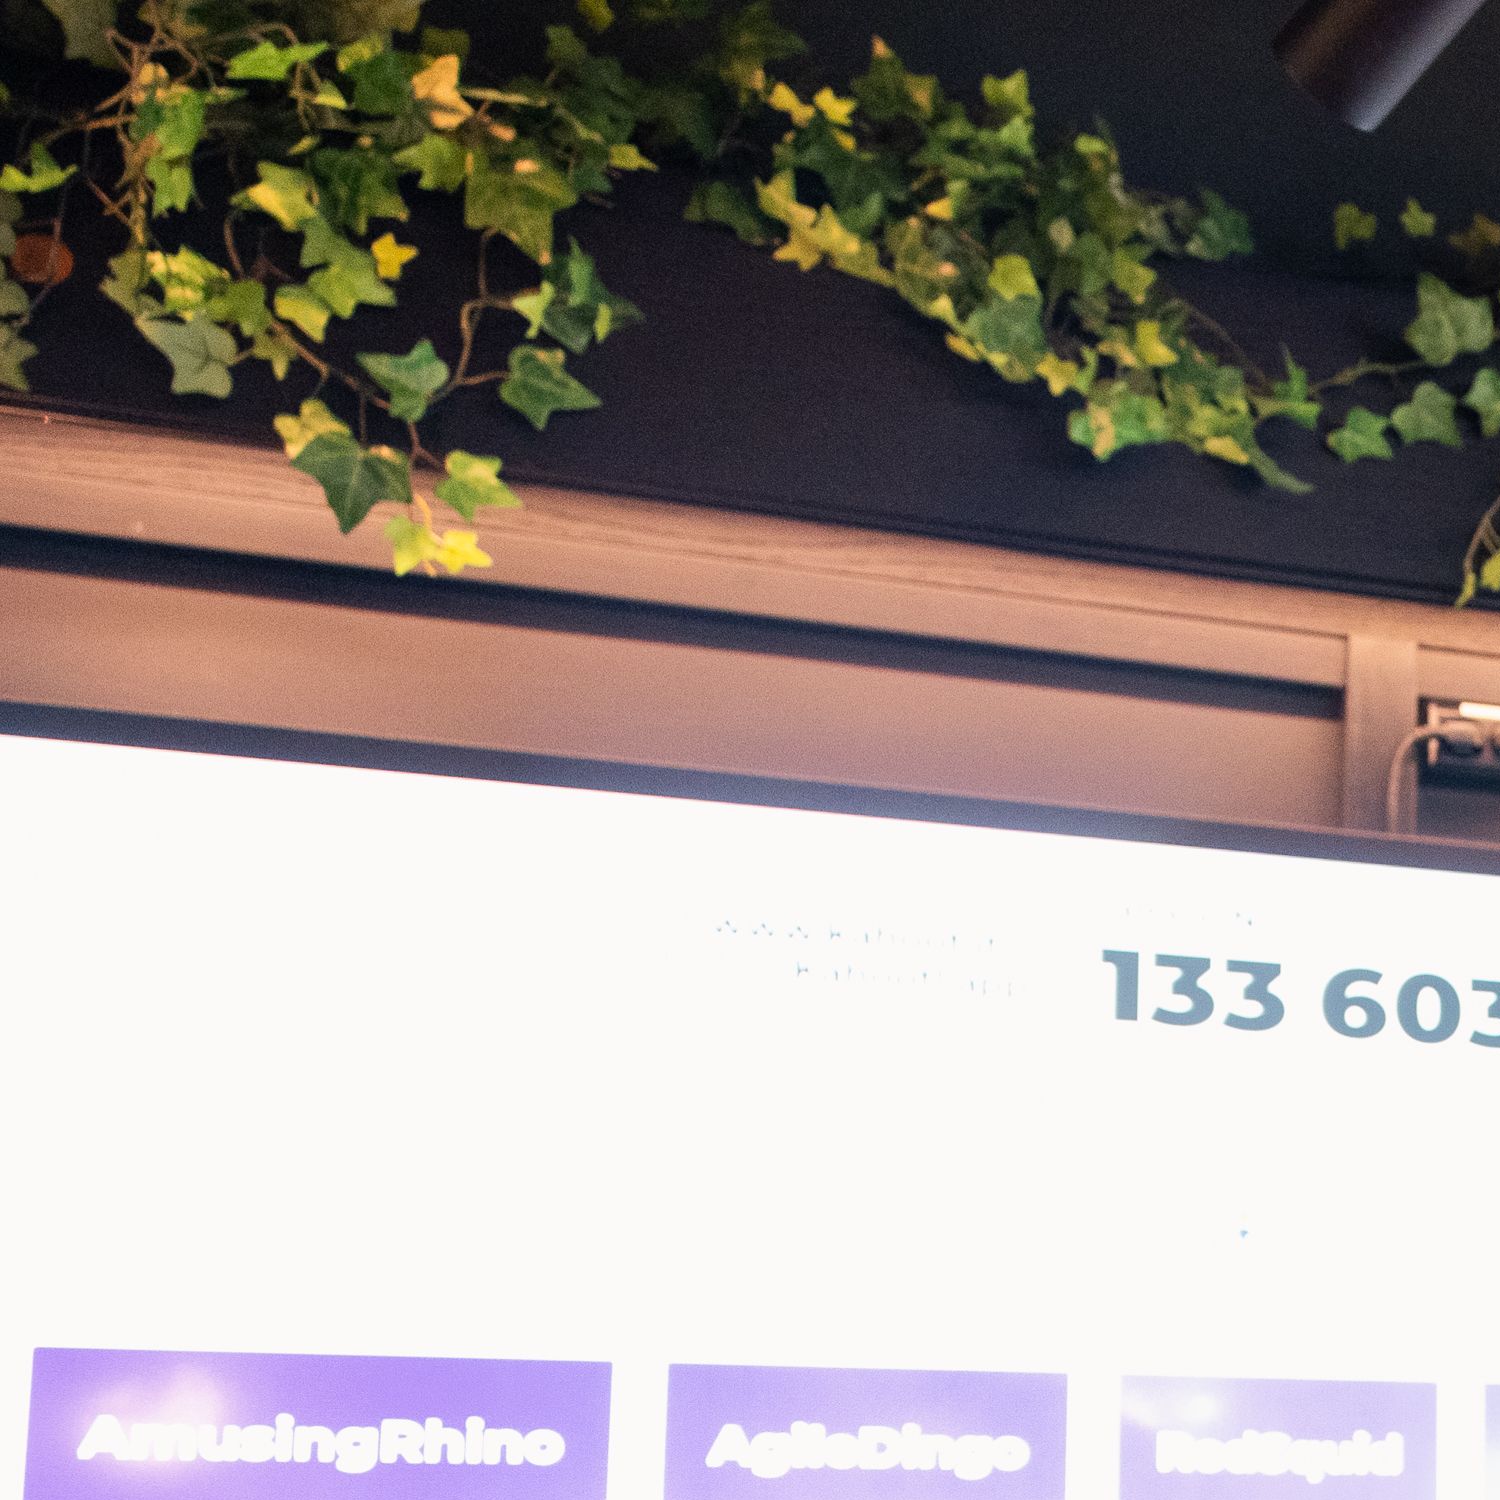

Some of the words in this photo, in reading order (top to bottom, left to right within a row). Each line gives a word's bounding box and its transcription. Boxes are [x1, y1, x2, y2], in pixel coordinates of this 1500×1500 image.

[1102, 949, 1286, 1031] 133
[77, 1412, 565, 1474] AmusingRhino
[706, 1420, 1031, 1481] AgileDingo
